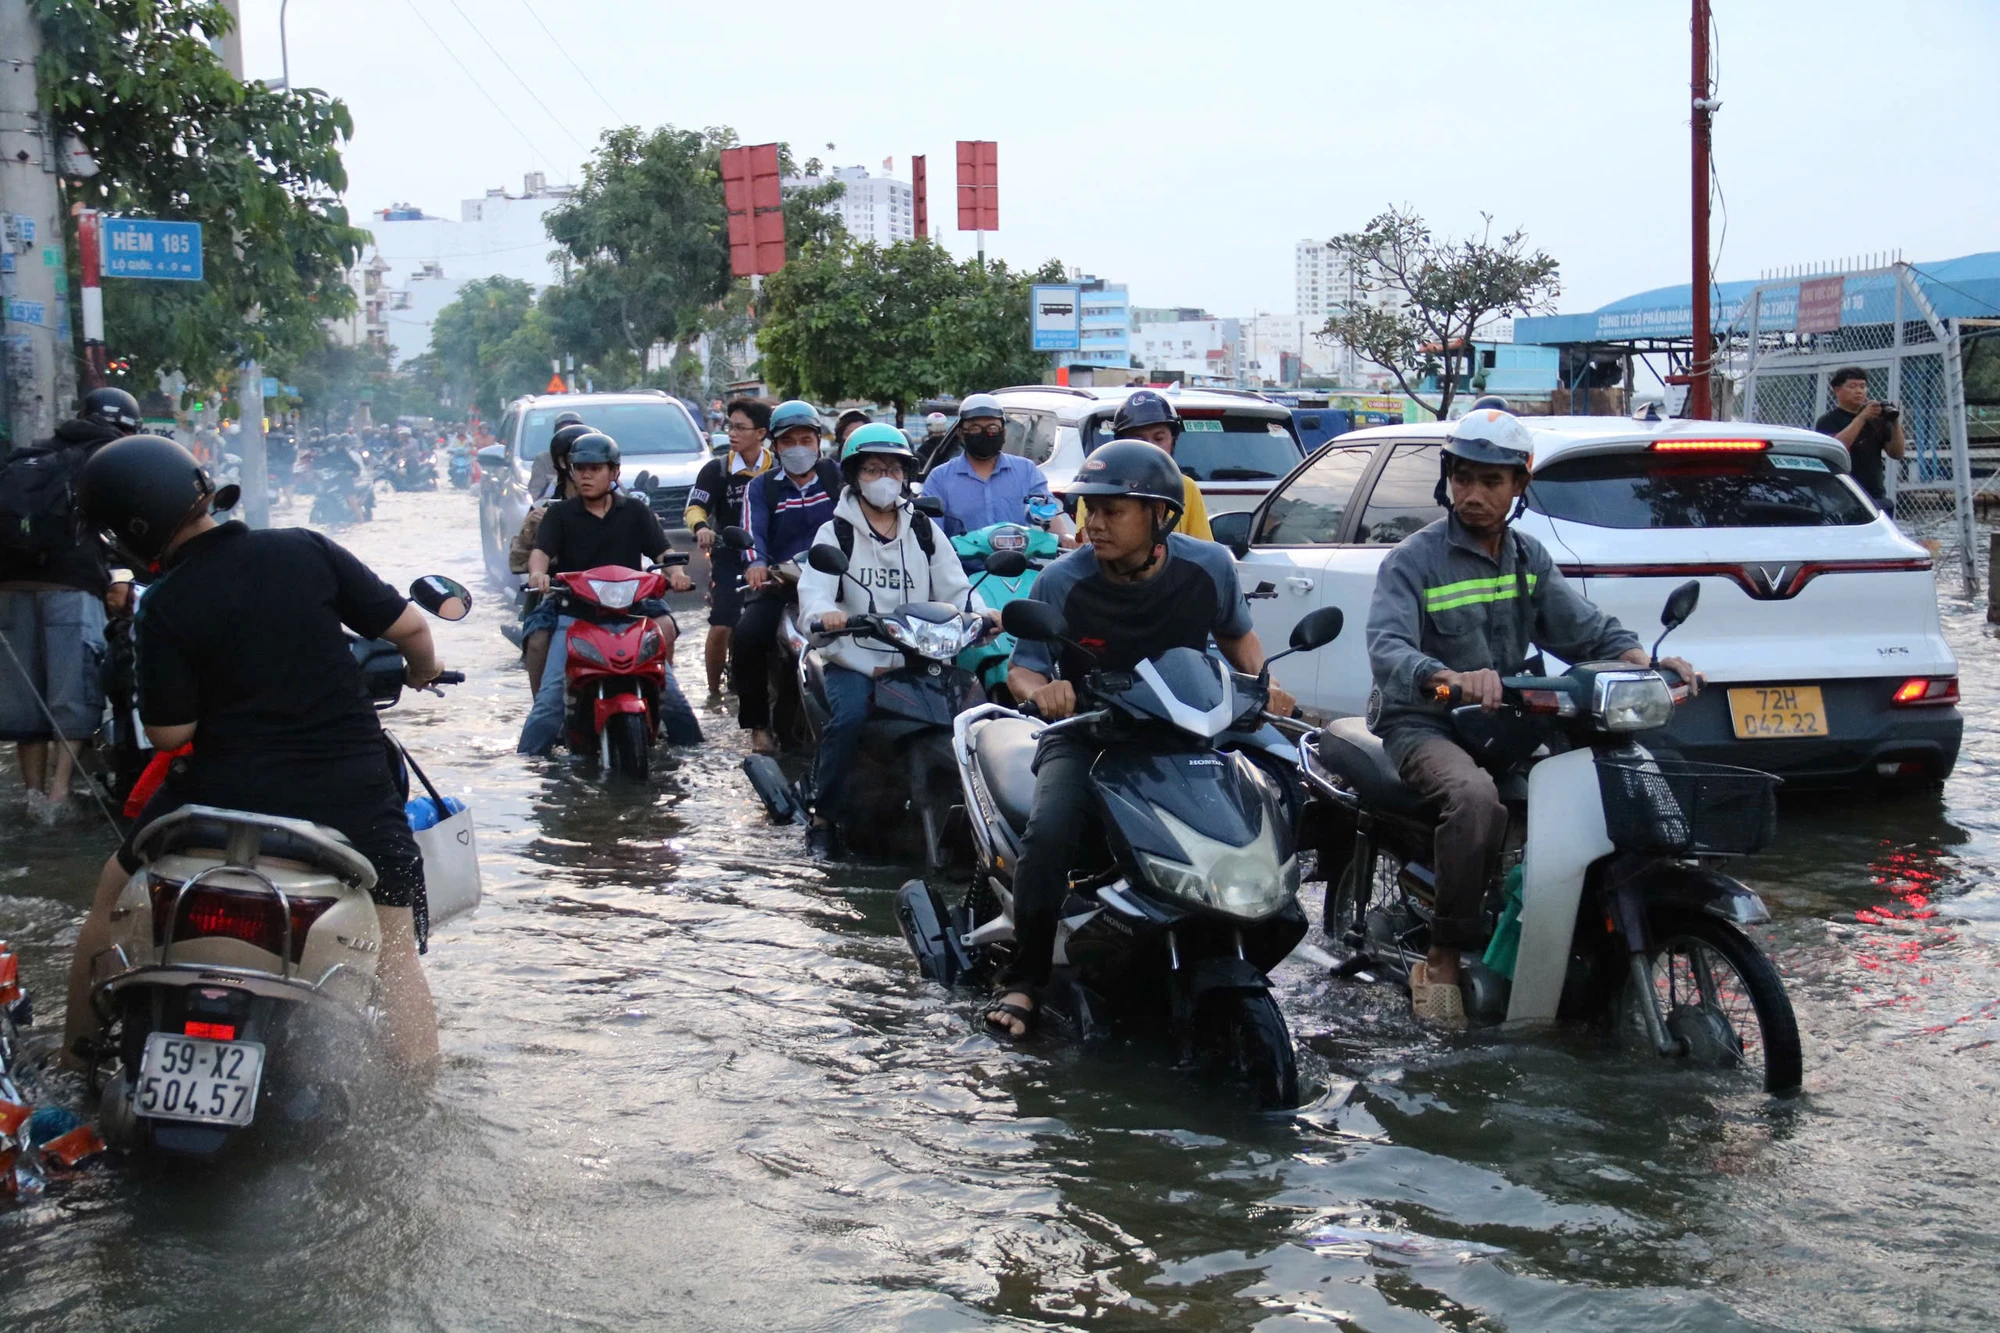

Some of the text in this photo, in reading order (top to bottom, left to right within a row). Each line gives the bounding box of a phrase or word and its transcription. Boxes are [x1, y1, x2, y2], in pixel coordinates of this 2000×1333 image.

[162, 234, 190, 253] 185
[1620, 314, 1629, 327] TY
[1756, 689, 1798, 710] 72H
[1744, 713, 1818, 735] 042.22
[1189, 759, 1225, 767] HONDA
[1103, 913, 1134, 937] HONDA
[161, 1041, 244, 1080] 59-X2
[142, 1076, 249, 1118] 504.57
